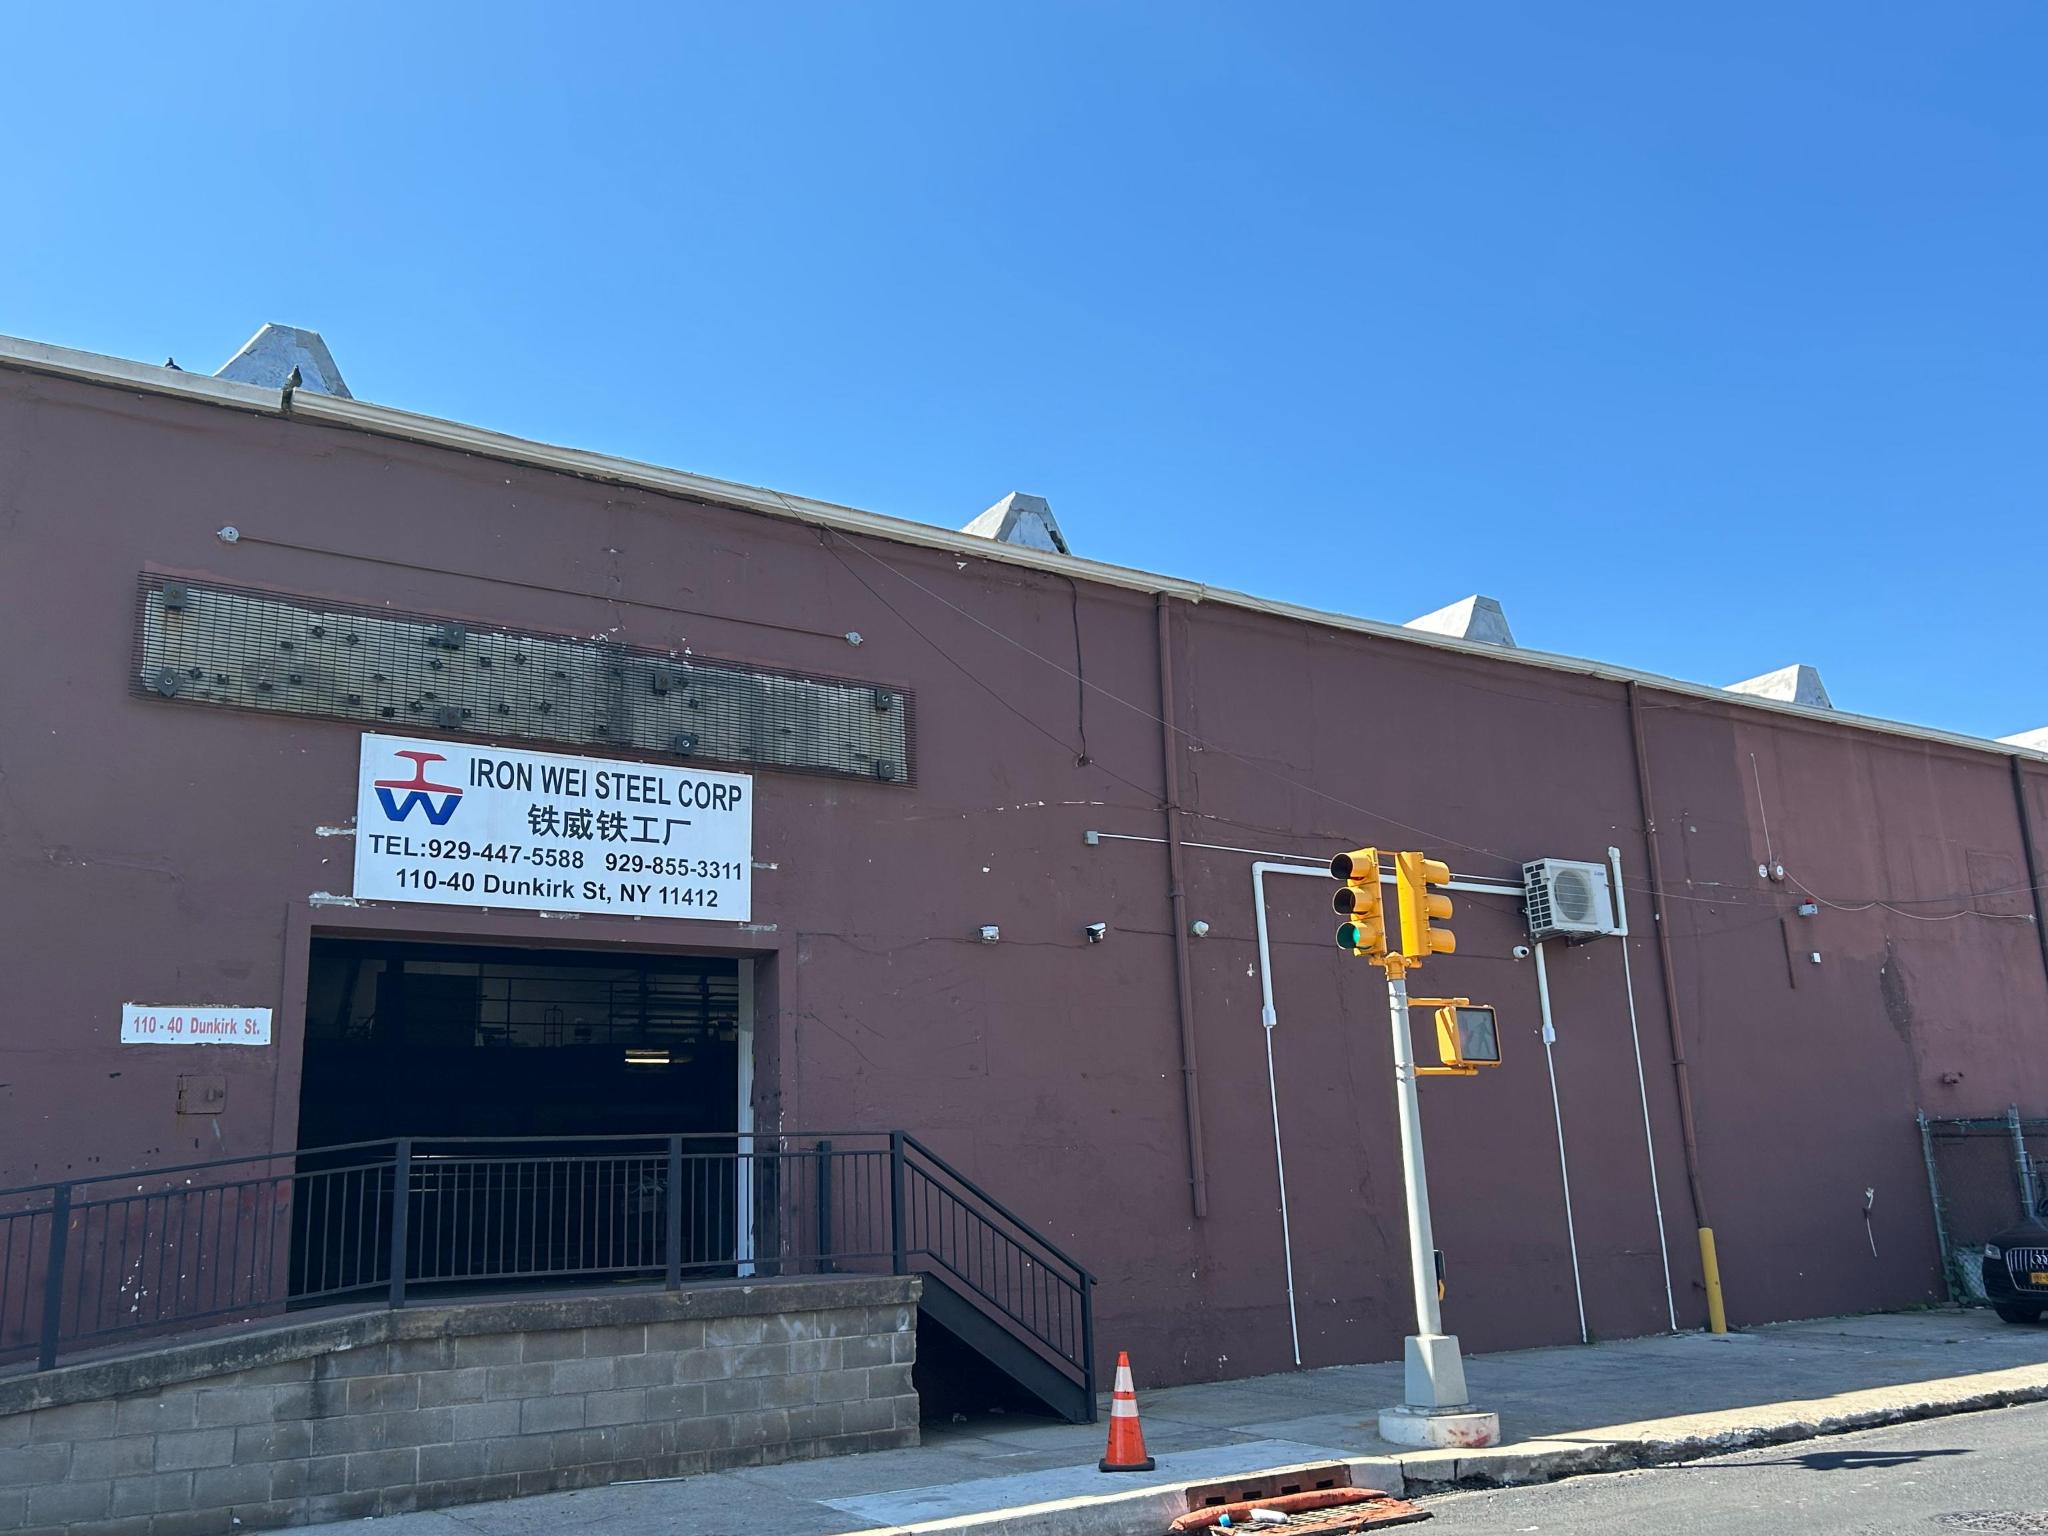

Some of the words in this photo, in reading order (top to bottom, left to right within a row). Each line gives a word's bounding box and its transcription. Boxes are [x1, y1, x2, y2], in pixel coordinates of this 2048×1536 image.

[469, 757, 533, 792] IRON
[540, 764, 587, 798] WEI
[594, 770, 672, 806] STEEL
[678, 779, 742, 812] CORP
[527, 803, 692, 846] 铁威铁工厂
[605, 852, 742, 881] 929-855-3311
[396, 868, 475, 893] 110-40
[483, 873, 576, 899] Dunkirk
[582, 880, 612, 905] St,
[620, 883, 652, 903] NY
[658, 885, 718, 908] 11412
[190, 1017, 237, 1035] Dunkirk
[244, 1018, 260, 1035] St.
